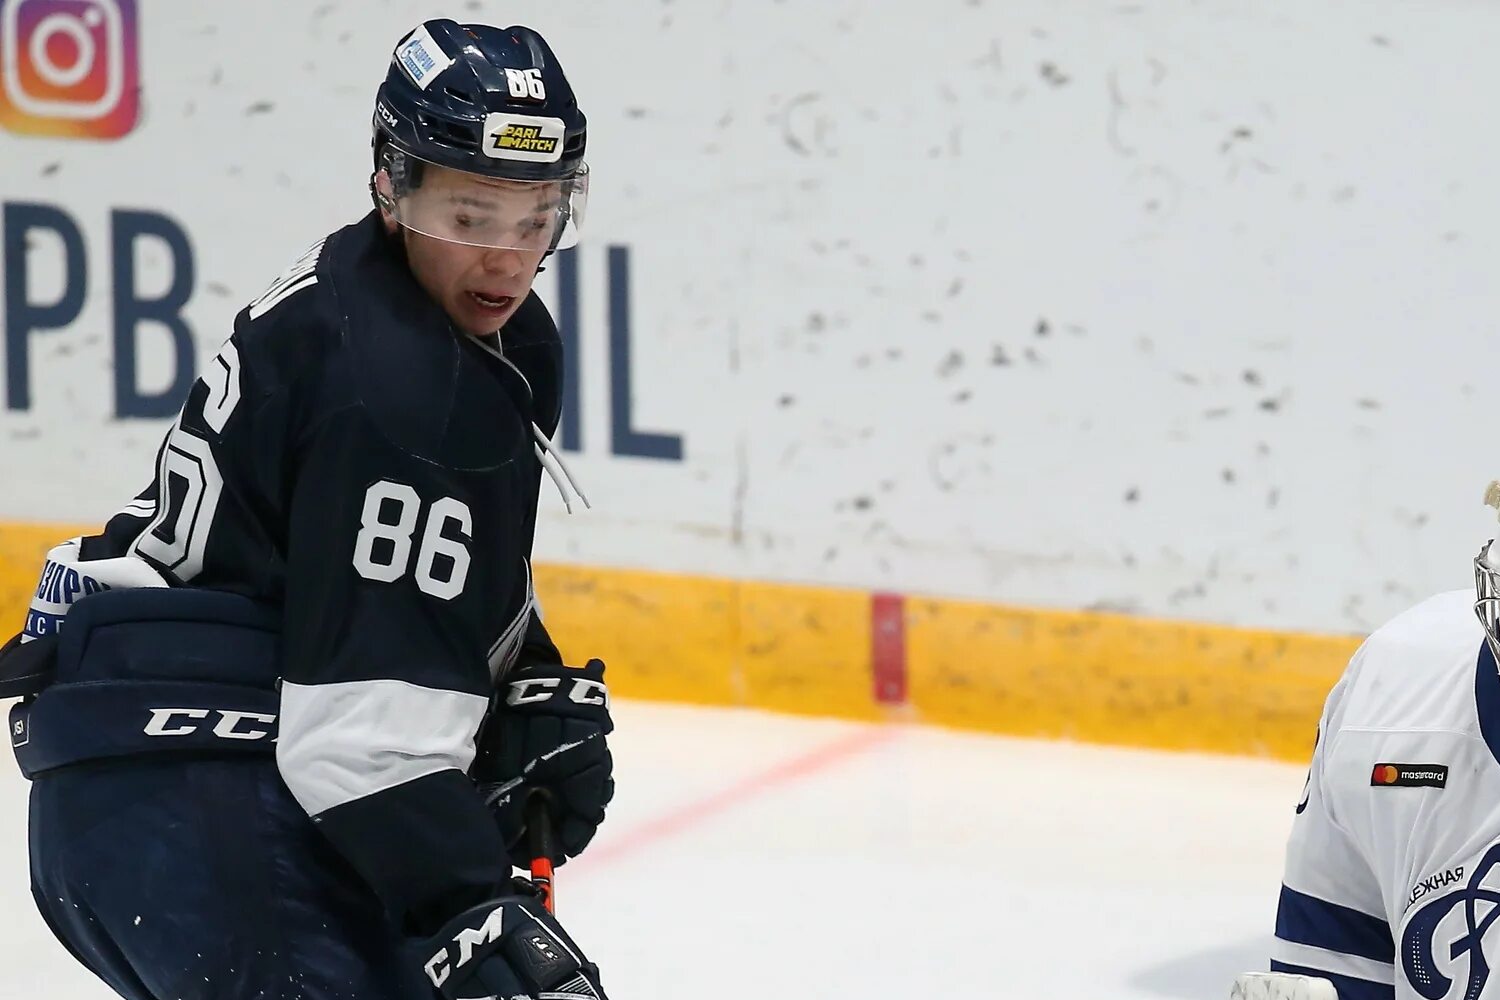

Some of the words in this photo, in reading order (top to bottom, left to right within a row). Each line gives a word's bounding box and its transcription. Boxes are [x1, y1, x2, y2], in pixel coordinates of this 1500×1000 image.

[504, 67, 546, 100] 86
[376, 101, 399, 128] CCM
[505, 126, 538, 138] PARI
[509, 136, 555, 151] MATCH
[352, 479, 474, 602] 86
[143, 707, 279, 743] CC
[1401, 770, 1445, 782] mastercard
